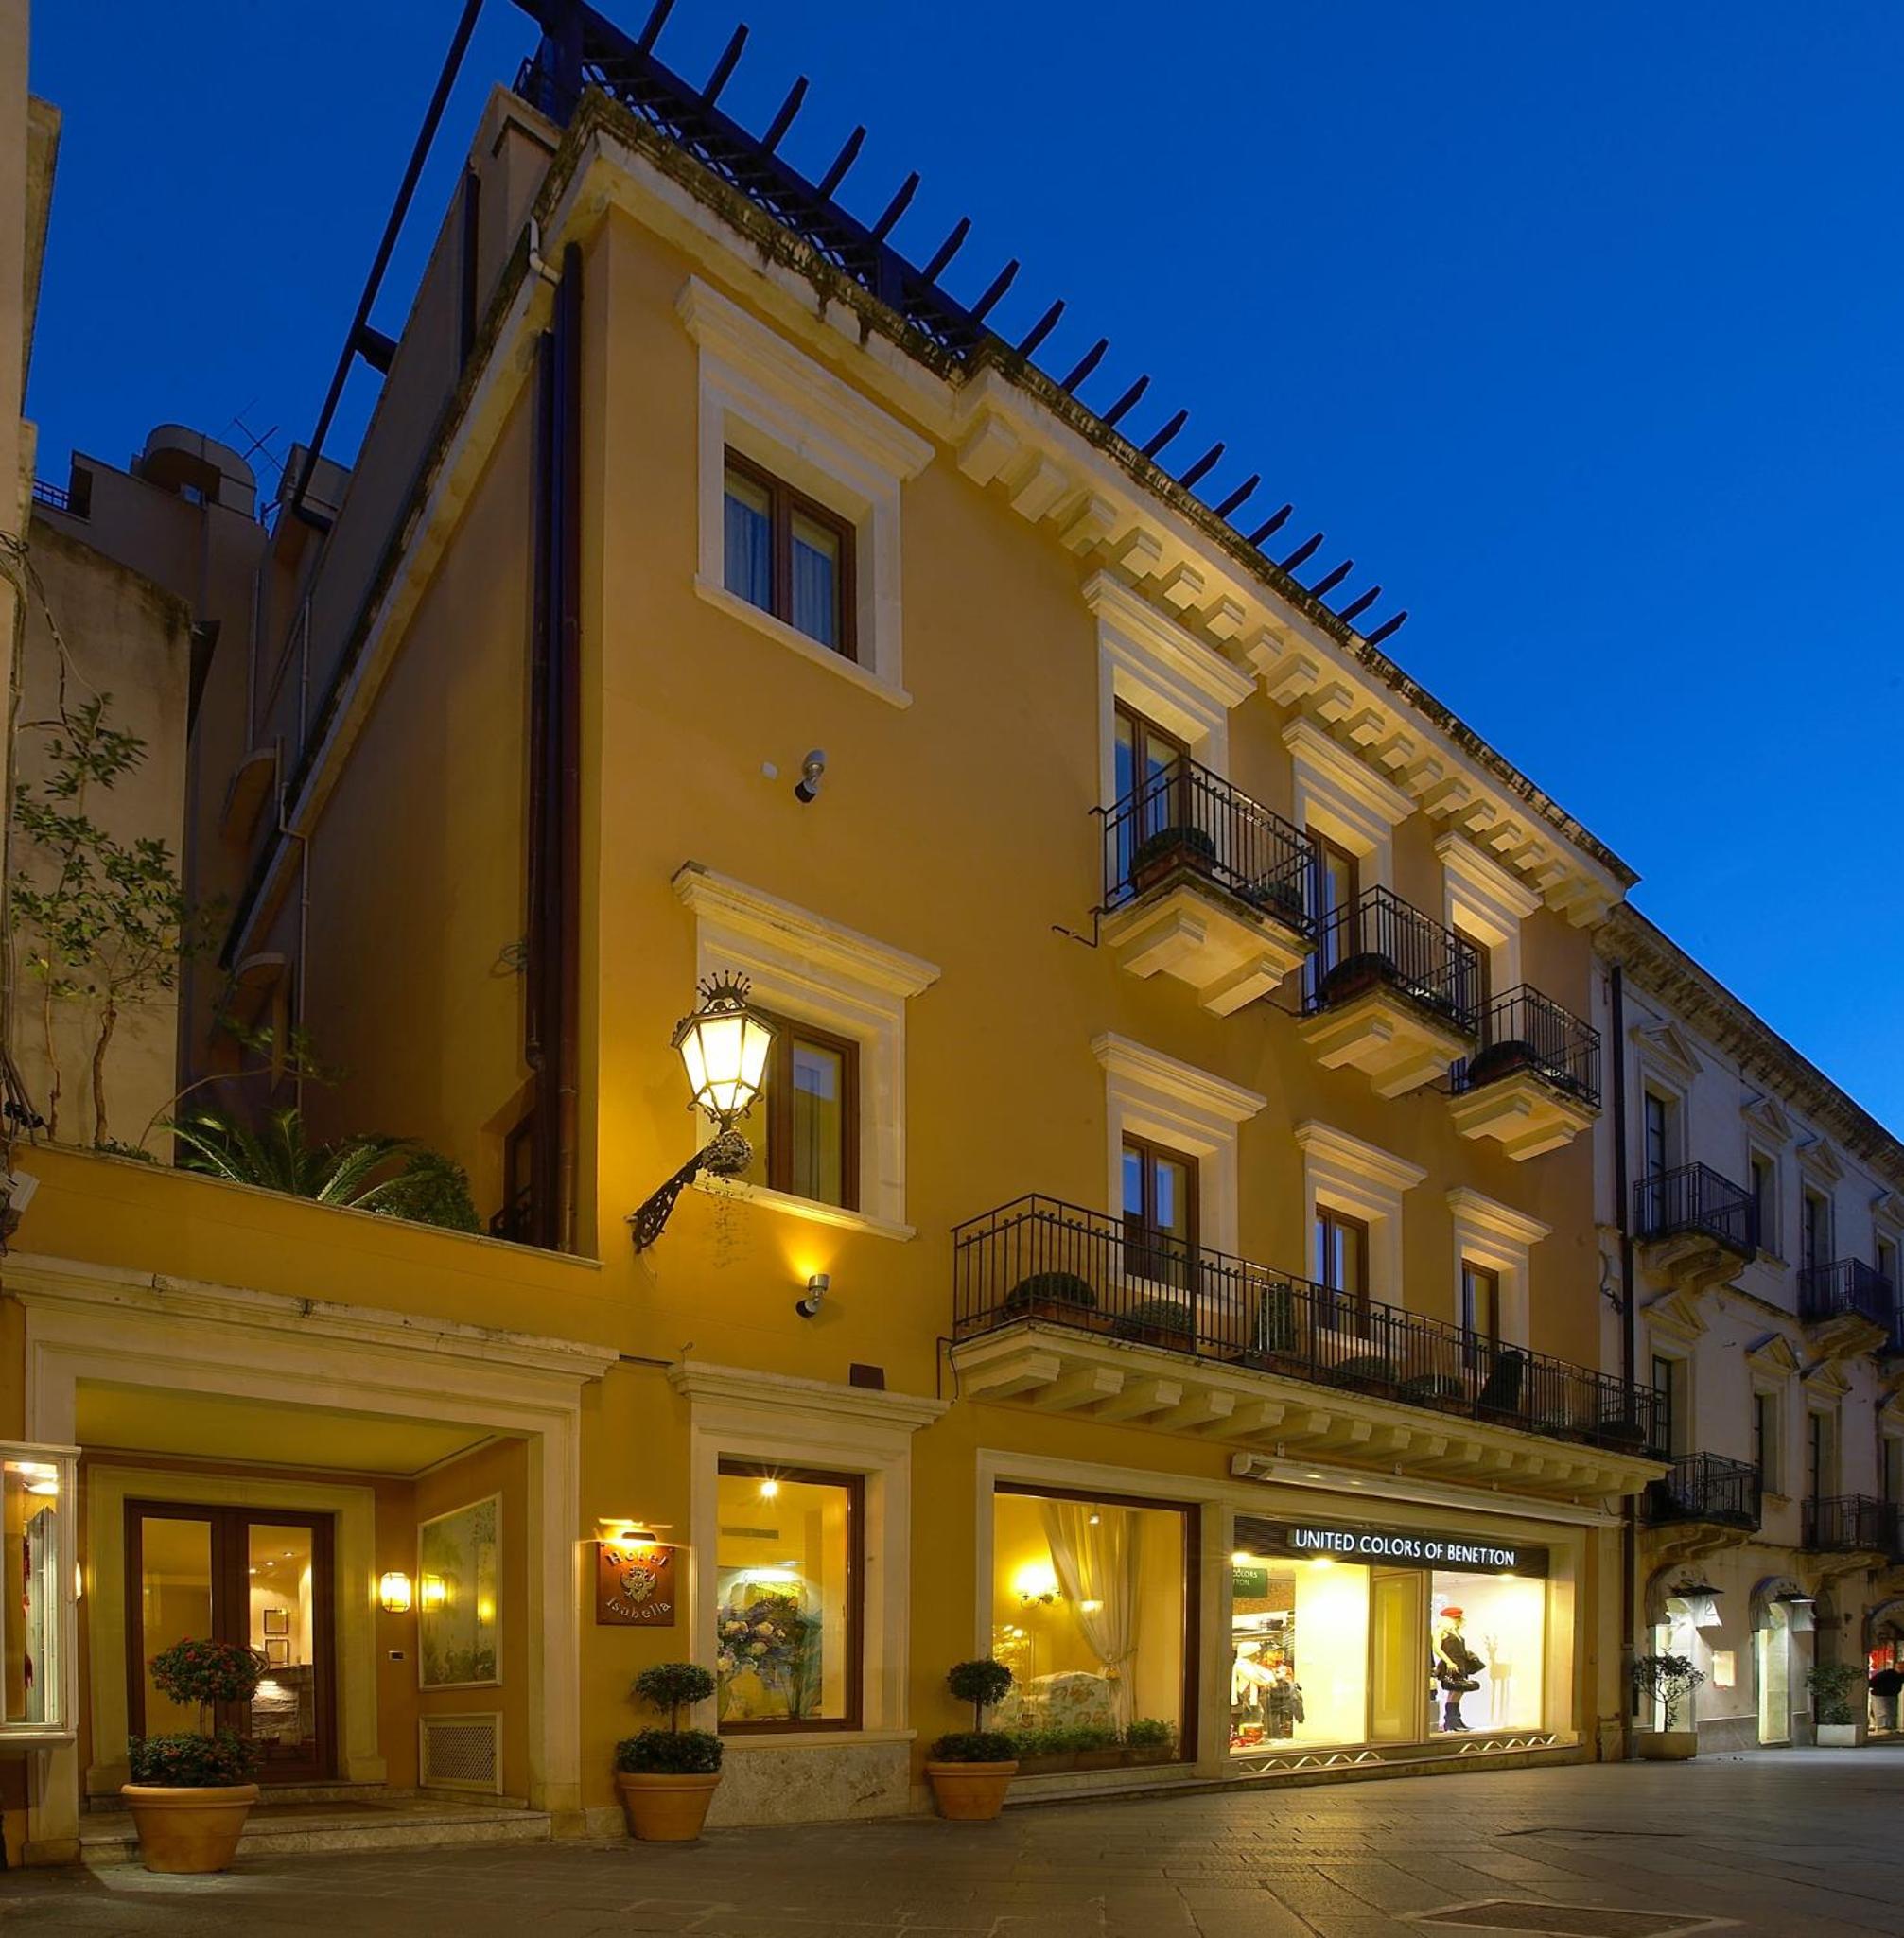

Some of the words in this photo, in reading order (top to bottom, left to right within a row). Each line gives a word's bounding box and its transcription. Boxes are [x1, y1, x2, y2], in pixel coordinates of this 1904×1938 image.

[606, 1551, 668, 1567] Hotel
[1295, 1529, 1355, 1551] UNITED
[1359, 1535, 1421, 1558] COLORS
[1424, 1542, 1444, 1560] OF
[1447, 1544, 1515, 1566] BENETTON
